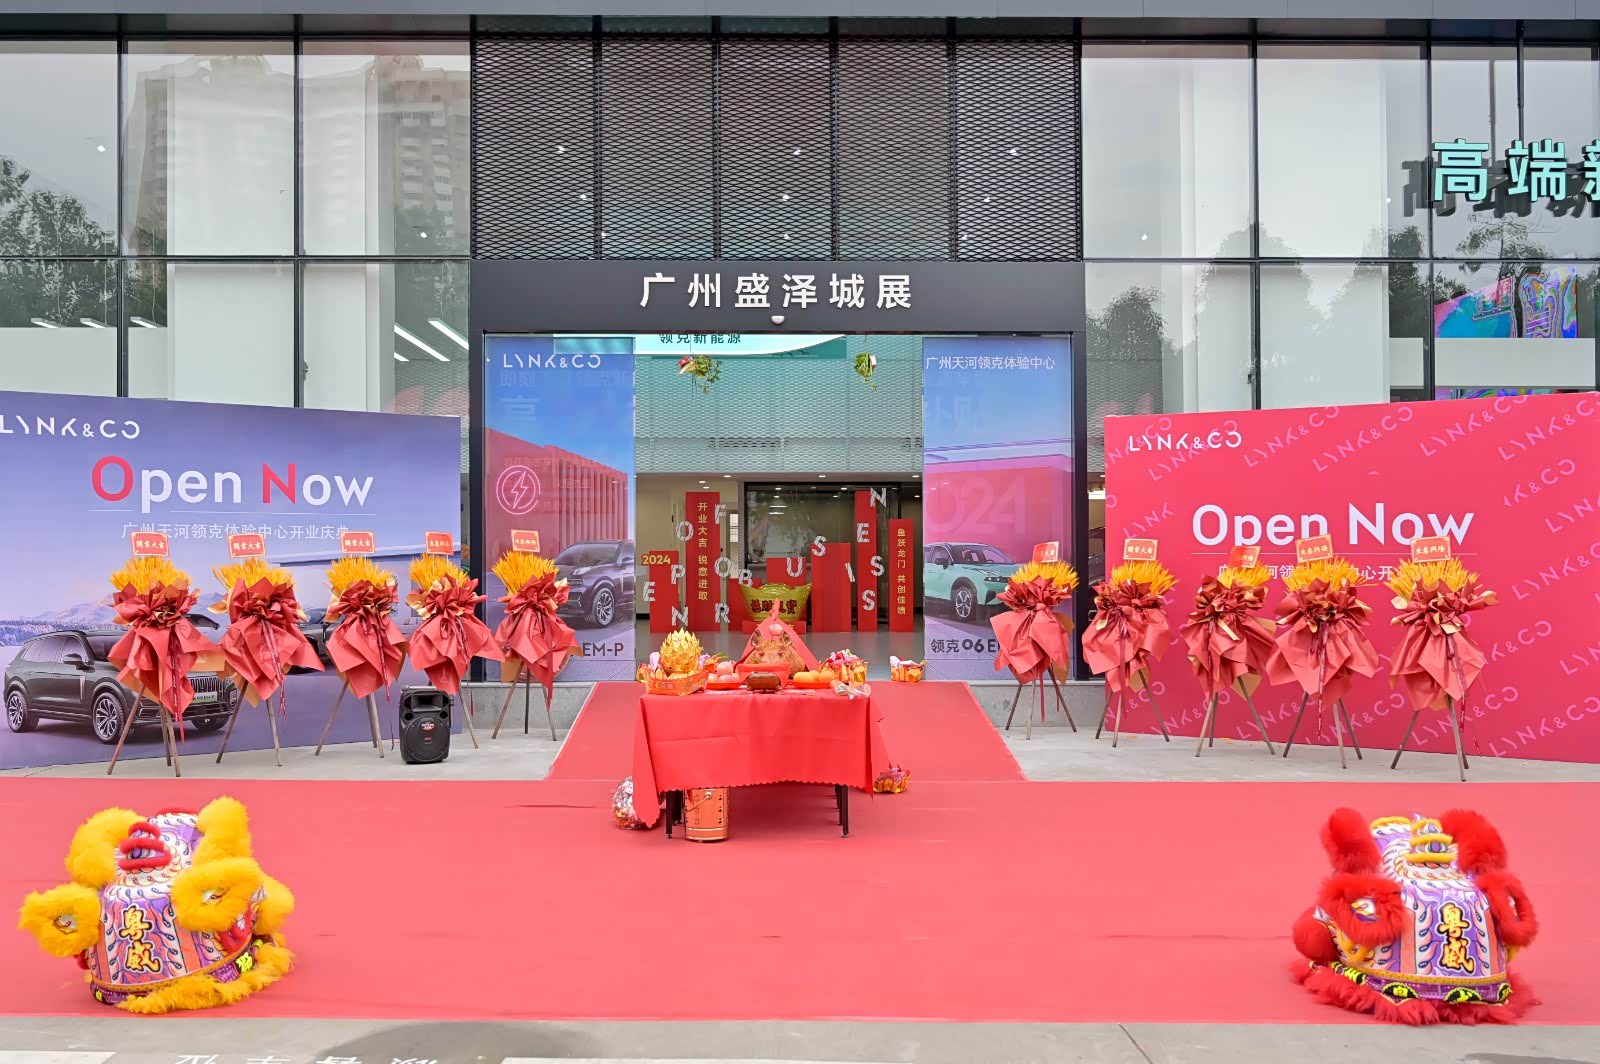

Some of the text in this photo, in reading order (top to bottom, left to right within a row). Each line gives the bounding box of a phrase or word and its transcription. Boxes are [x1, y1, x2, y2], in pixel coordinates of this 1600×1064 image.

[1433, 138, 1600, 202] 高端
[640, 272, 912, 309] 广州盛泽城展
[504, 353, 601, 369] LYNK&CO
[925, 356, 1056, 370] 广州天河领克体验中心
[92, 455, 374, 514] Open Now
[1192, 502, 1475, 546] Open Now
[642, 554, 671, 565] 2024
[697, 502, 709, 601] 开业大吉 锐意进取
[897, 528, 907, 569] 鱼跃龙门
[582, 642, 625, 657] EM-P
